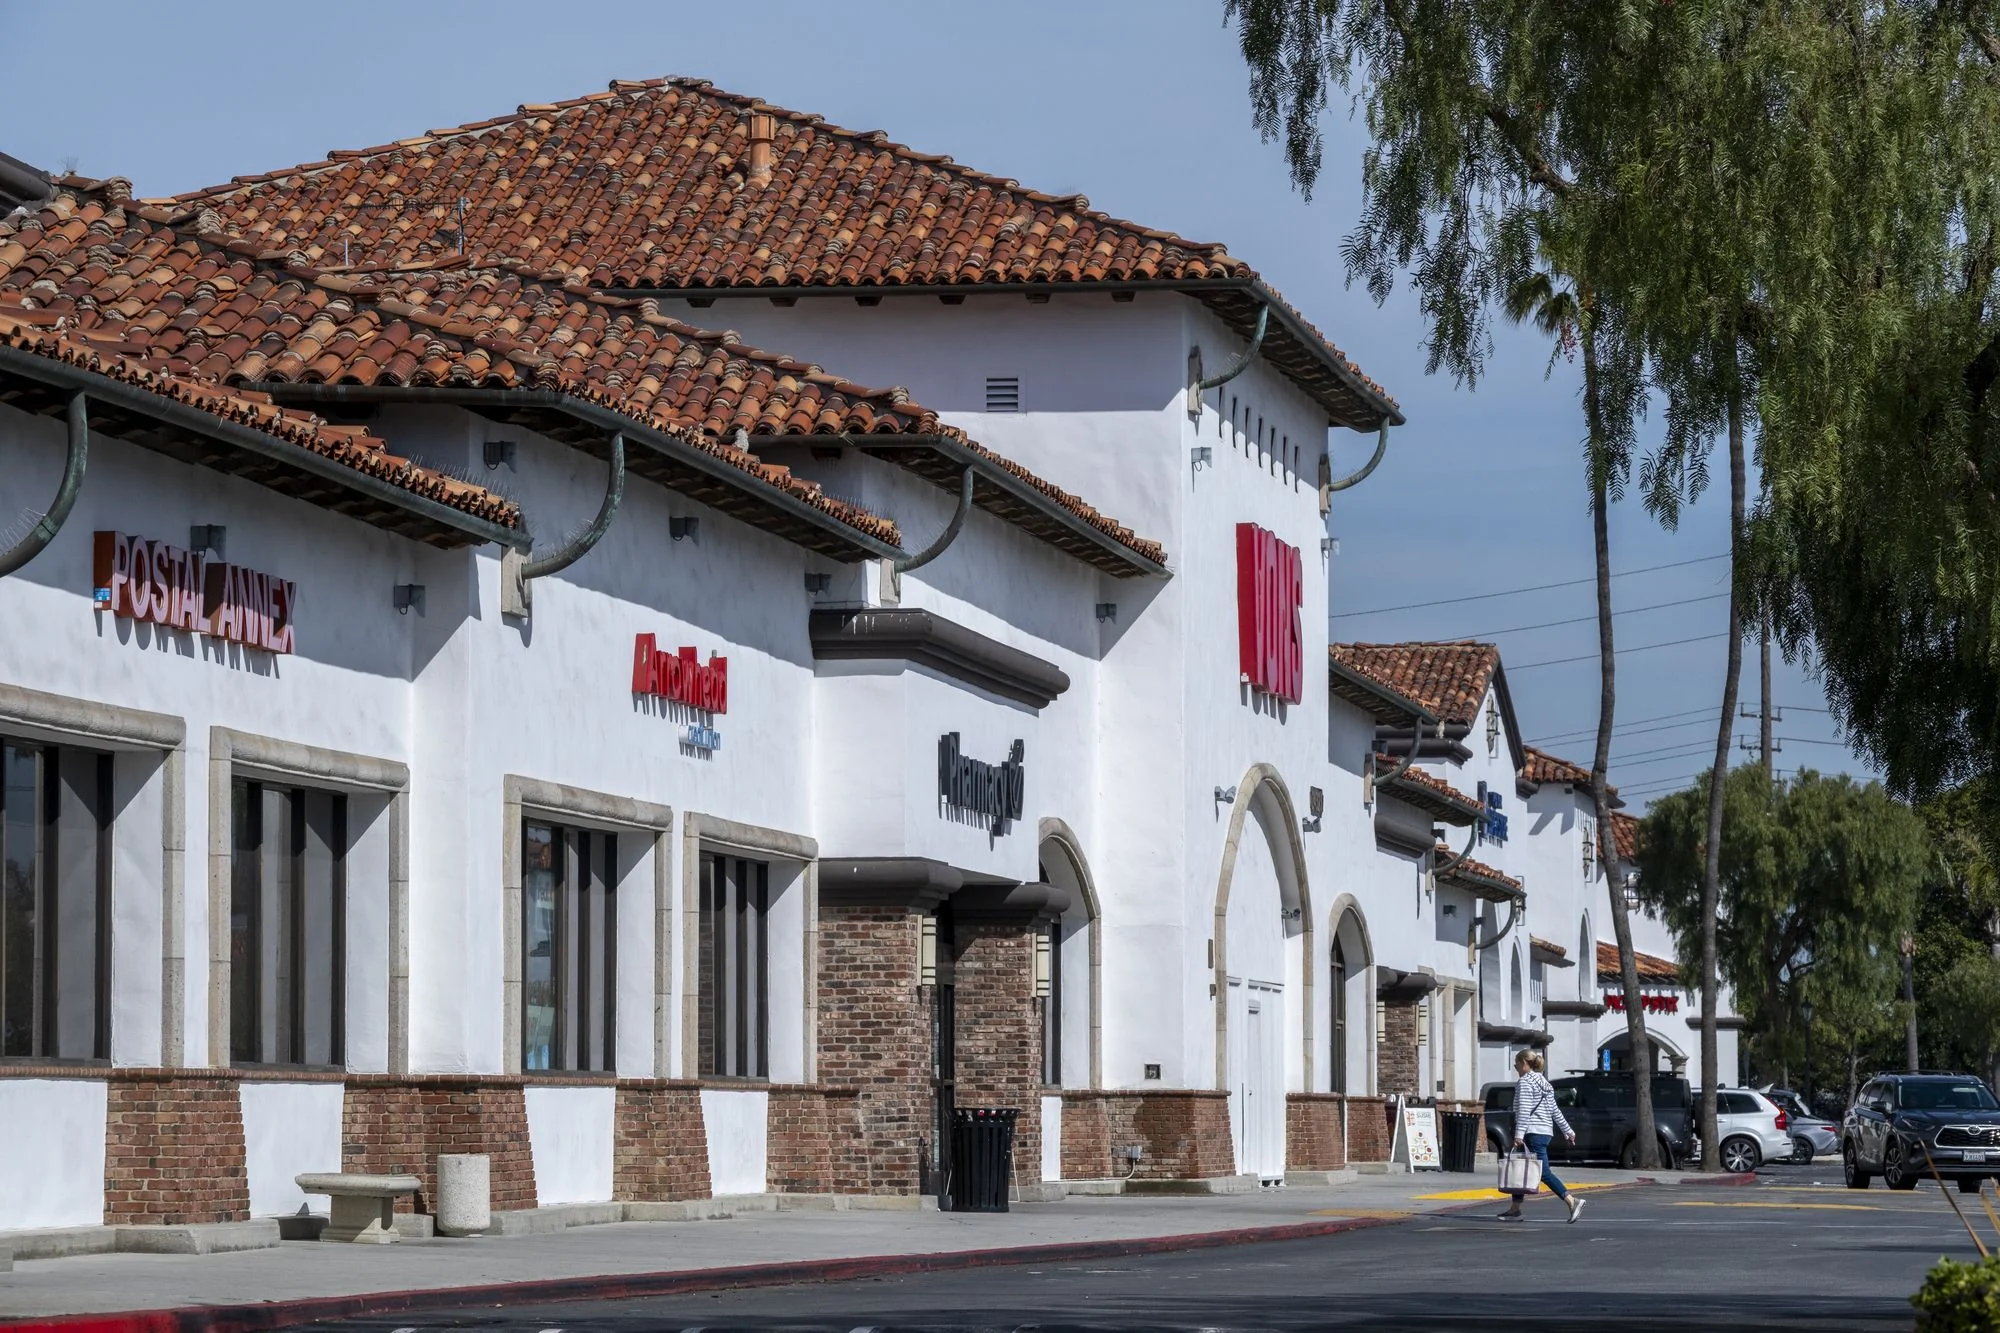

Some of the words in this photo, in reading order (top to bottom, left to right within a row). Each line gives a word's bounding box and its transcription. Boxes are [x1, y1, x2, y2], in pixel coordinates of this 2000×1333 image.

[105, 531, 211, 635] POSTAL
[215, 563, 297, 655] ANNEX
[1246, 522, 1304, 706] VONS
[640, 633, 727, 714] Arrowhead
[943, 732, 1008, 836] Pharmacy
